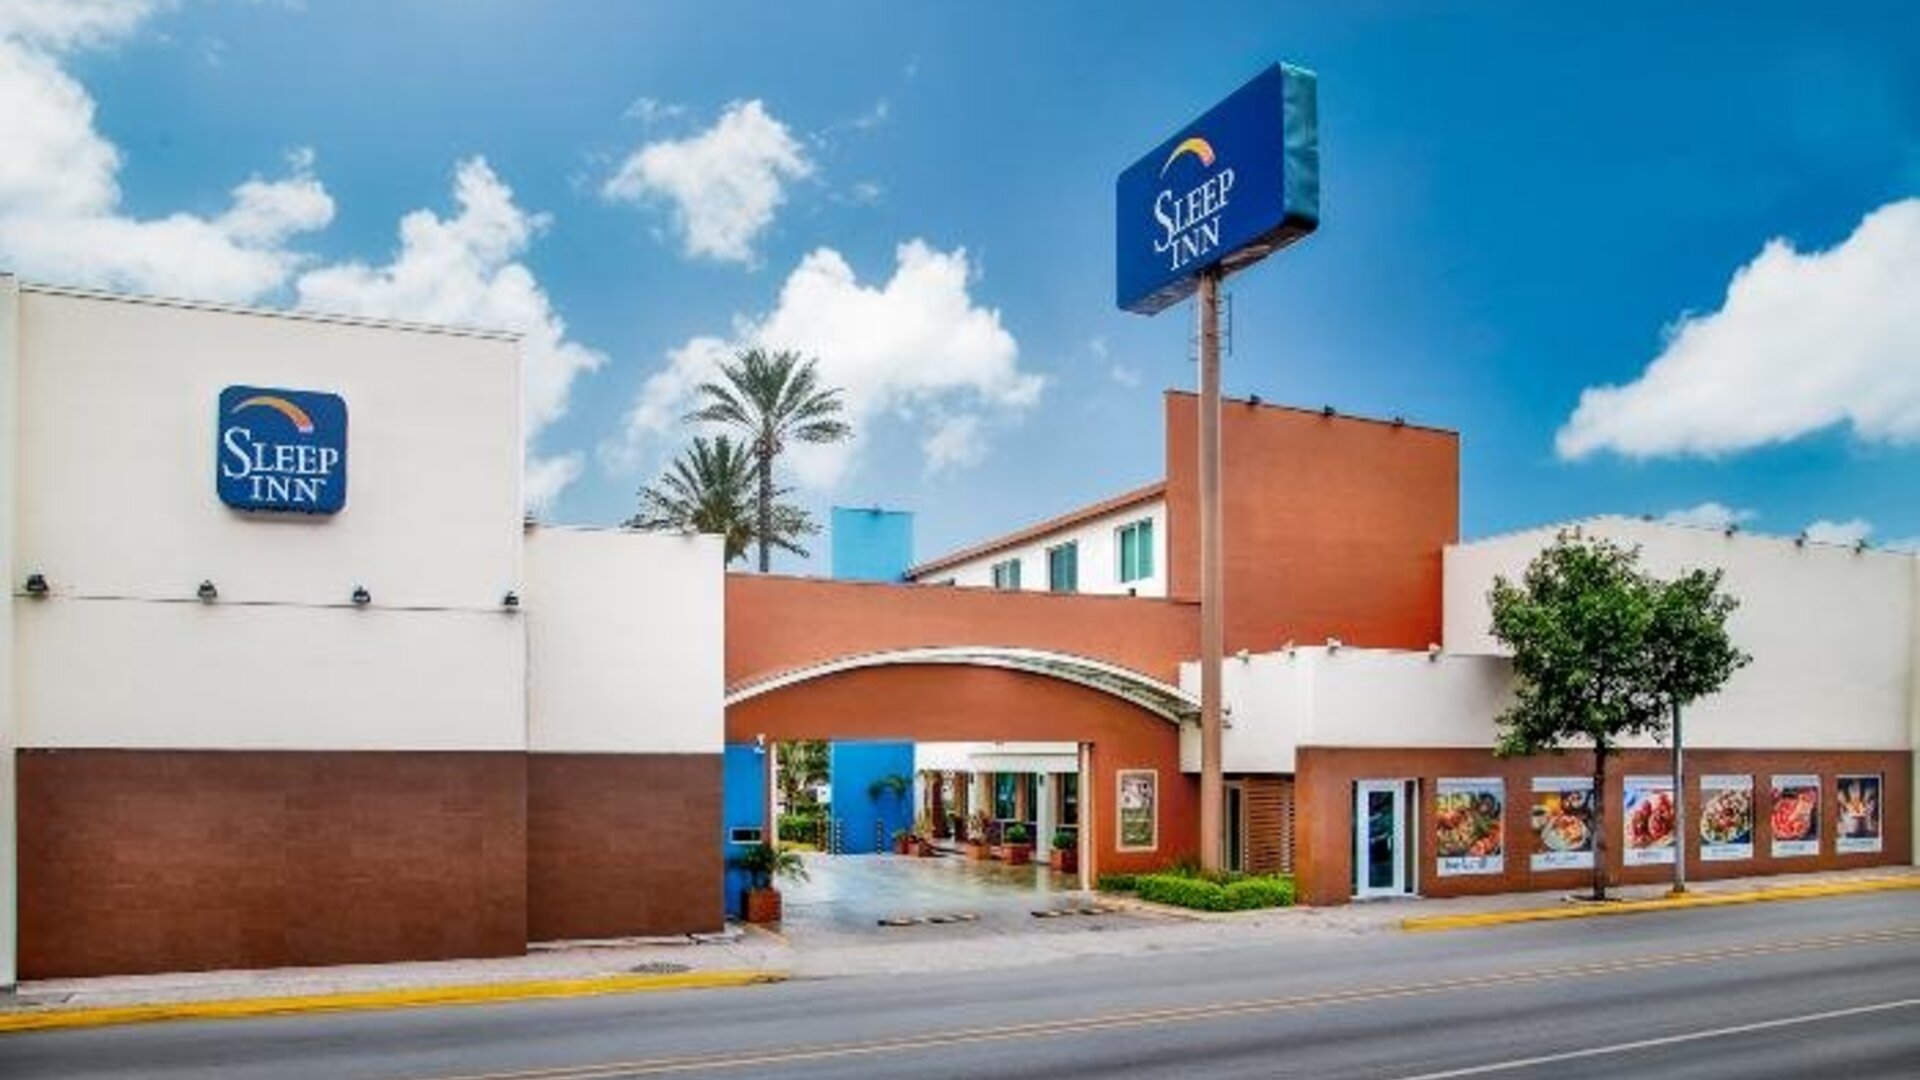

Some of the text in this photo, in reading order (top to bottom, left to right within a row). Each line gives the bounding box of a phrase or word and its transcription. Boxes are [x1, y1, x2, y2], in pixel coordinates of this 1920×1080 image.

[1154, 168, 1235, 251] SLEEP
[1169, 214, 1221, 271] INN
[222, 426, 339, 479] SLEEP
[250, 475, 318, 502] INN
